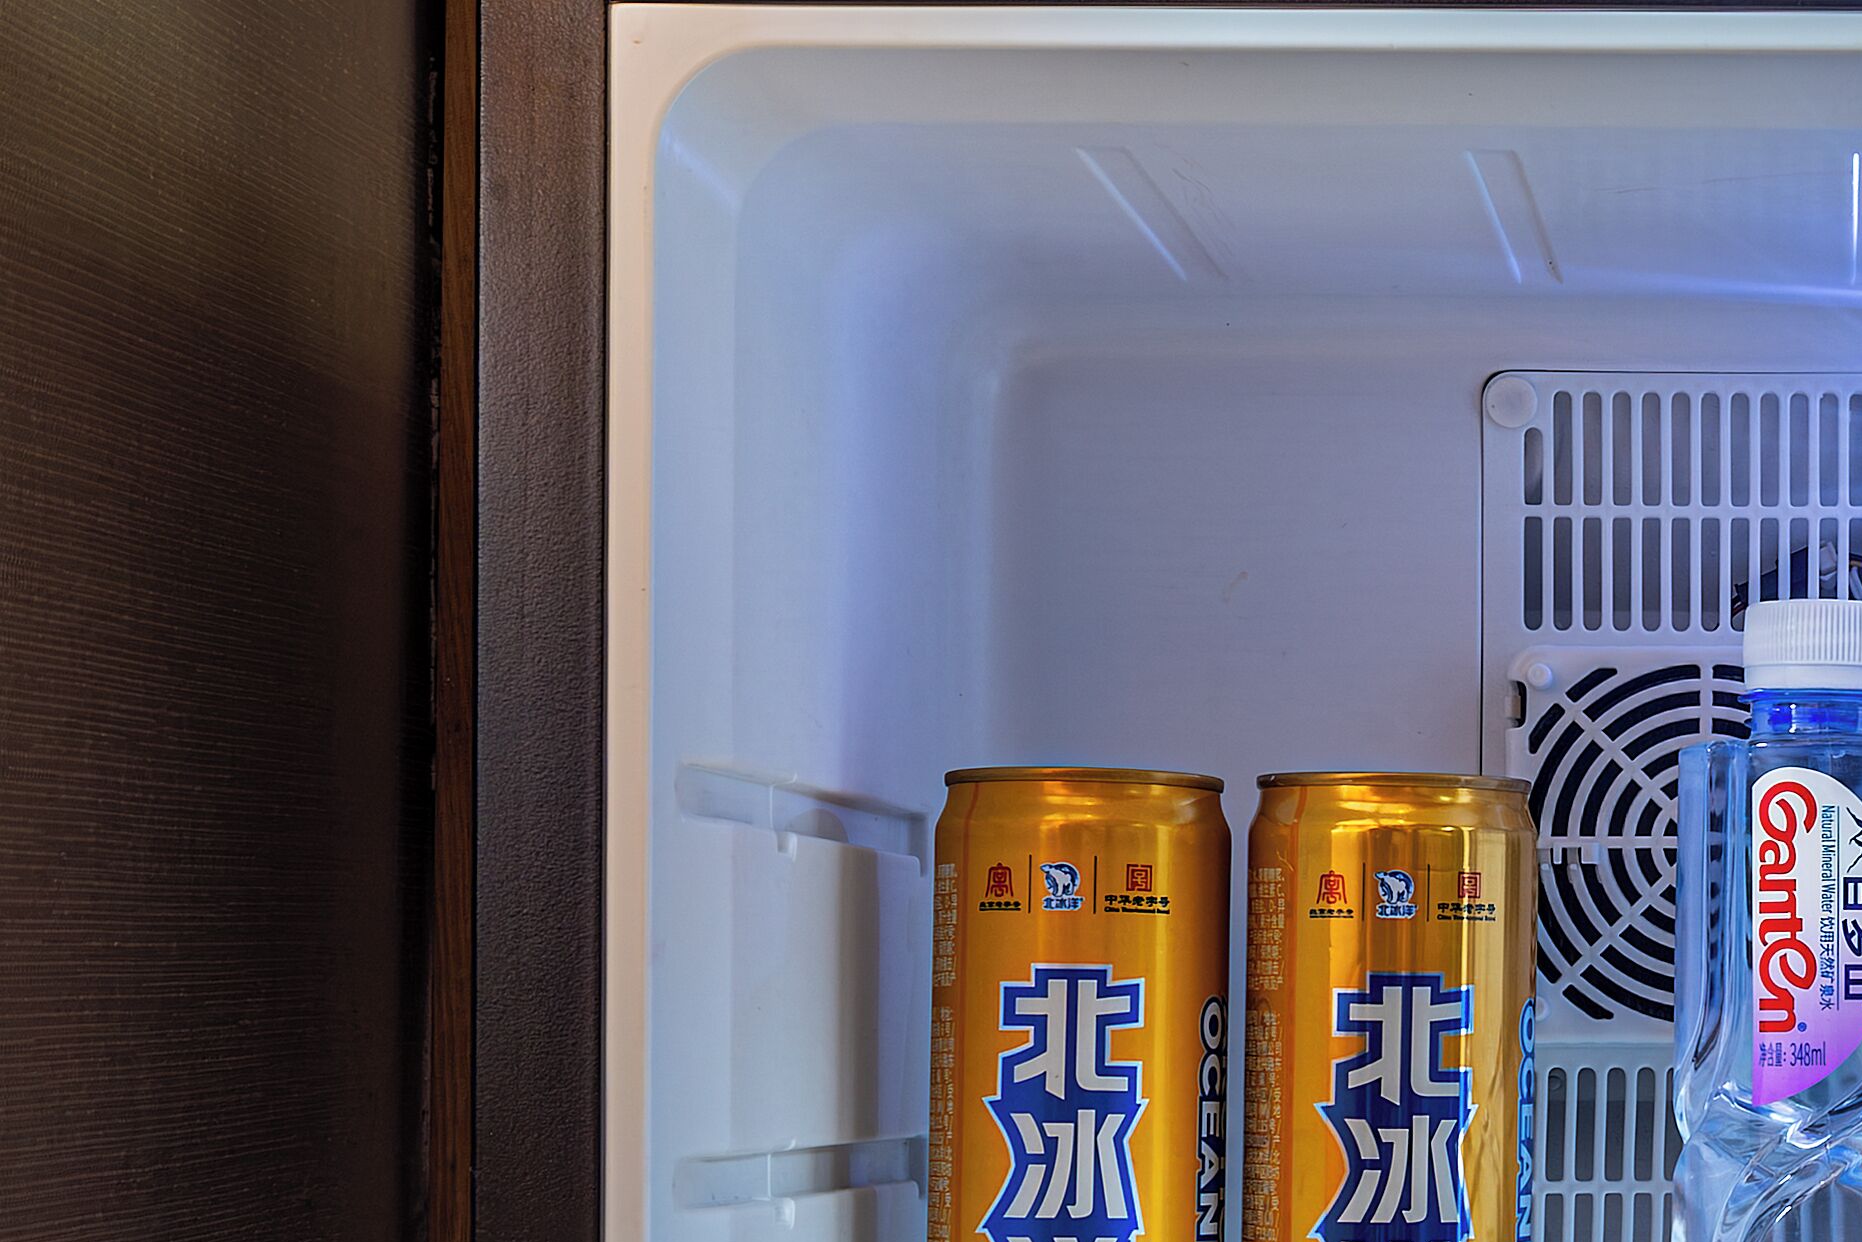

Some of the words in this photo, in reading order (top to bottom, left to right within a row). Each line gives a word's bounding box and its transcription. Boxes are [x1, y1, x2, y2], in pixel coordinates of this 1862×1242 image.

[1821, 805, 1835, 842] Natural
[1821, 844, 1835, 884] Mineral
[1759, 781, 1818, 1033] Ganten
[1821, 885, 1835, 913] Water
[1790, 1041, 1826, 1067] 348ml
[1199, 1001, 1222, 1236] OCEAN
[1518, 1002, 1535, 1237] OCEAN
